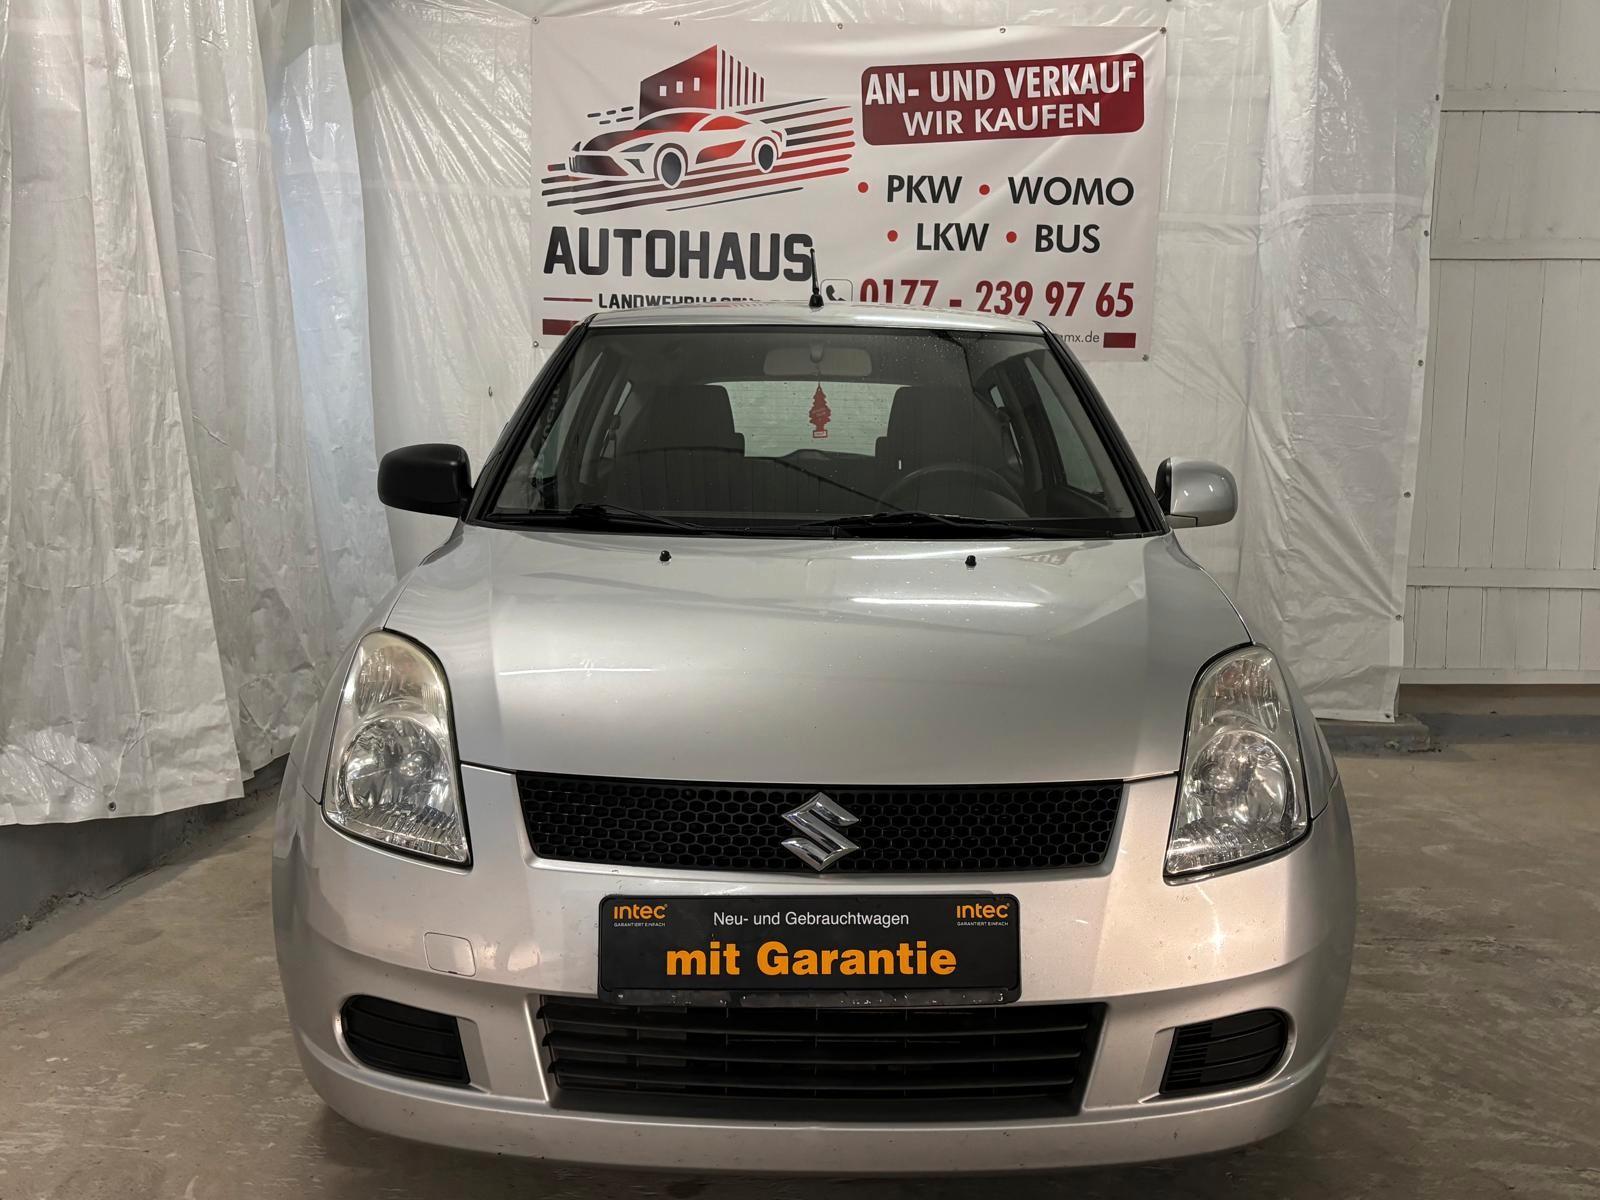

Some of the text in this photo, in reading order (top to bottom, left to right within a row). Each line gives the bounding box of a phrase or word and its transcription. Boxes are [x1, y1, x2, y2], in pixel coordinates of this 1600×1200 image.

[865, 61, 1137, 105] AN- UND VERKAUF
[902, 102, 1100, 136] WIR KAUFEN
[887, 175, 1134, 206] PKW WOMO
[543, 226, 814, 281] AUTOHAUS
[916, 223, 1101, 253] LKW BUS
[860, 278, 939, 307] 0177
[975, 280, 1034, 316] 239
[1045, 281, 1086, 317] 97
[1095, 282, 1134, 317] 65
[614, 903, 666, 920] intec
[713, 911, 909, 929] Neu- und Gebrauchtwagen
[956, 903, 1009, 919] intec
[666, 940, 957, 976] mit Garantie
